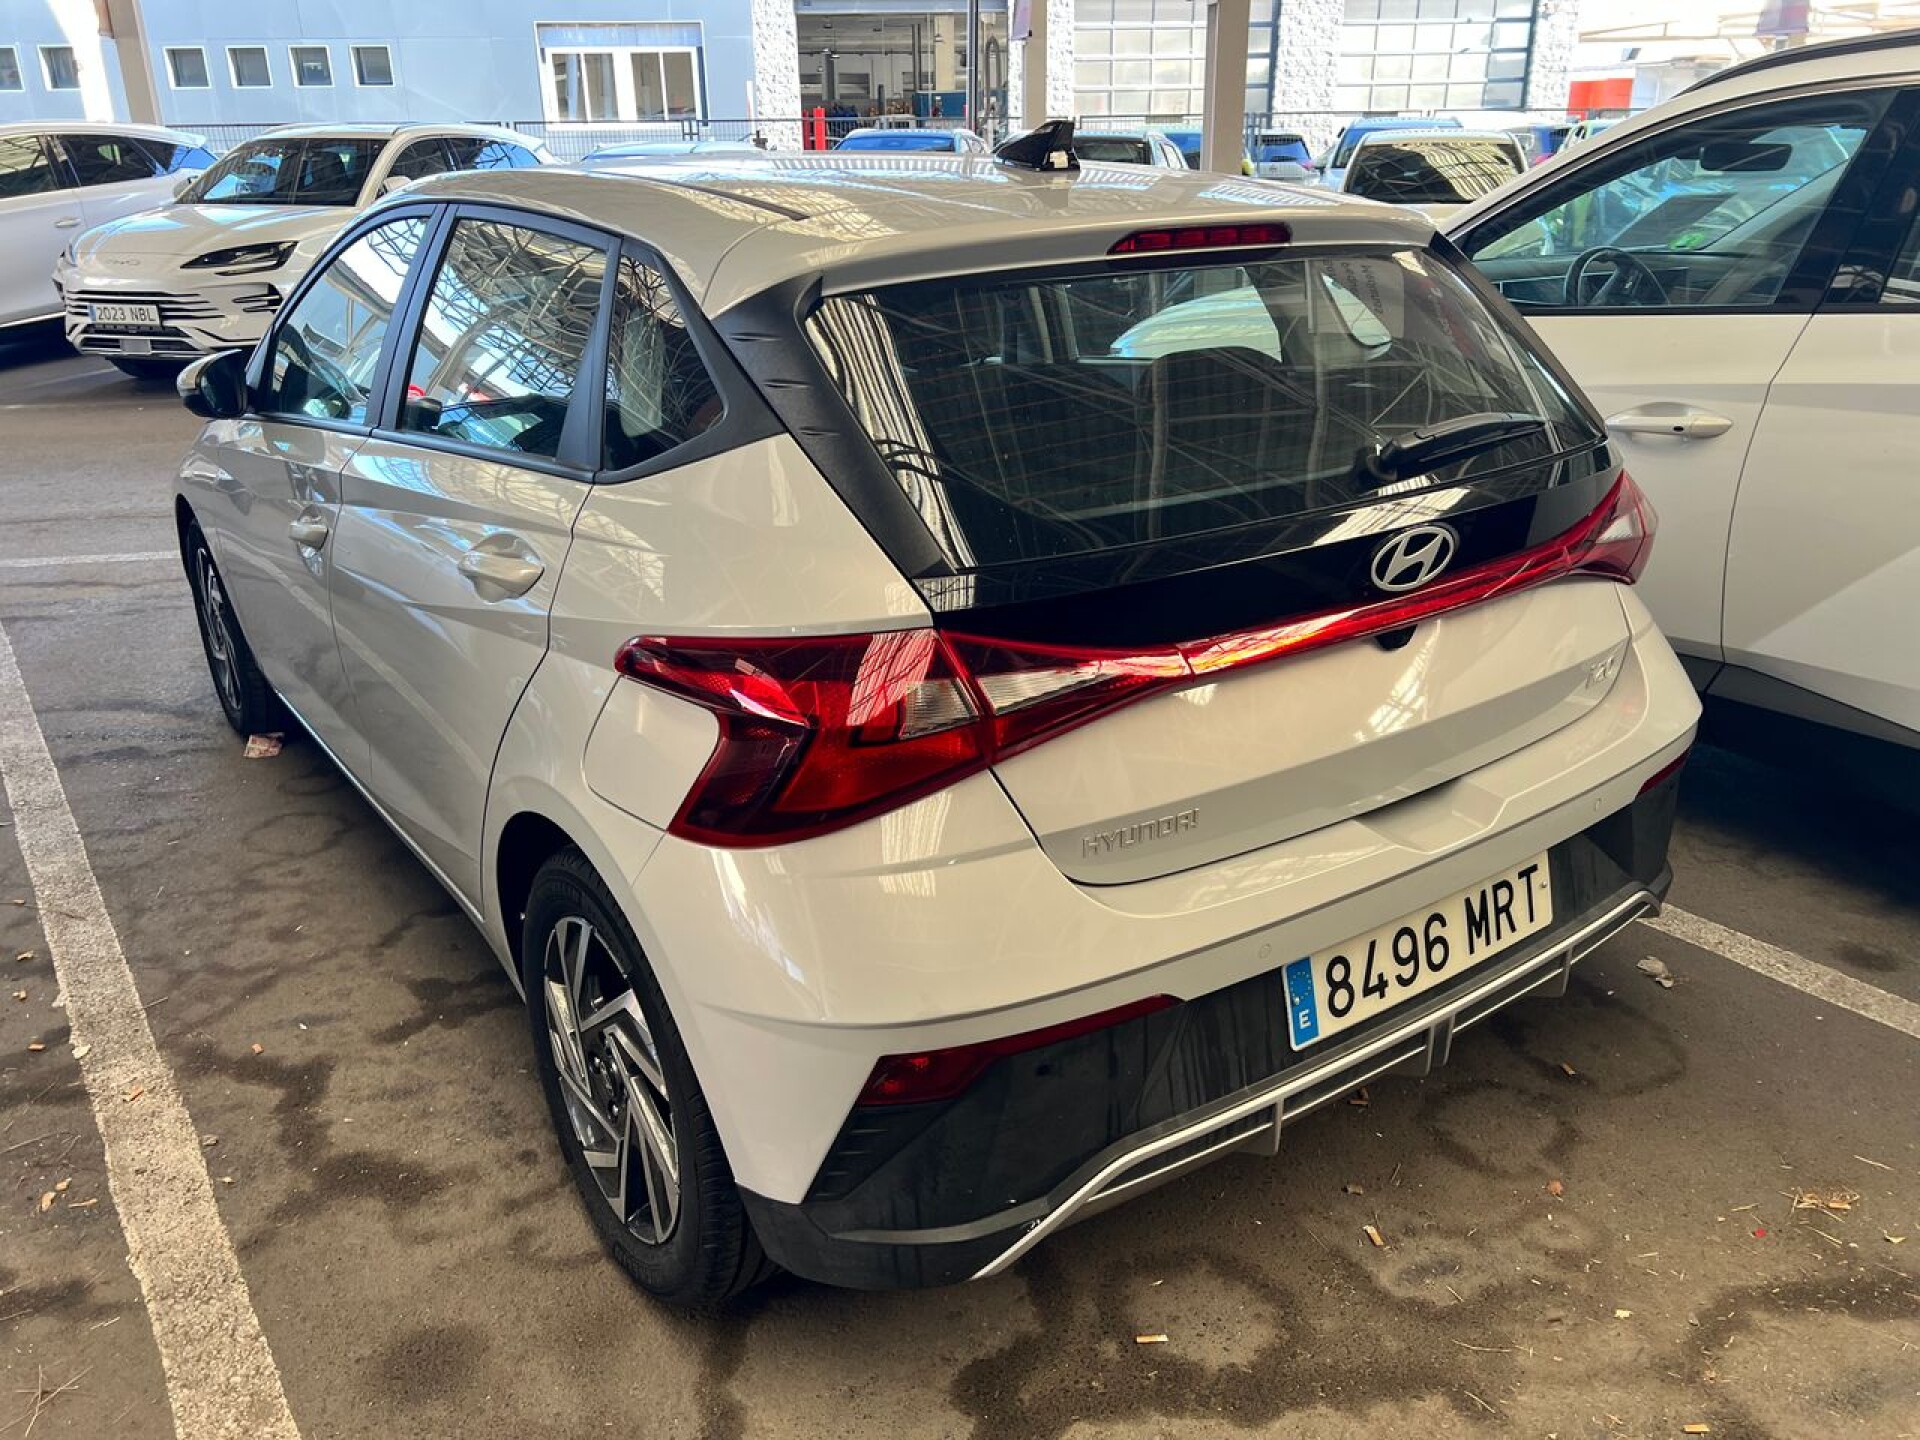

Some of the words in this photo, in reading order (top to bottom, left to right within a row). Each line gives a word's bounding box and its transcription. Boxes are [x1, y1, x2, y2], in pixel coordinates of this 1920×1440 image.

[97, 306, 126, 320] 2023
[130, 307, 156, 322] NBL
[1082, 808, 1199, 859] HYUNDAI
[1325, 912, 1450, 1018] 8496
[1464, 863, 1538, 956] MRT
[1299, 1009, 1312, 1028] E
